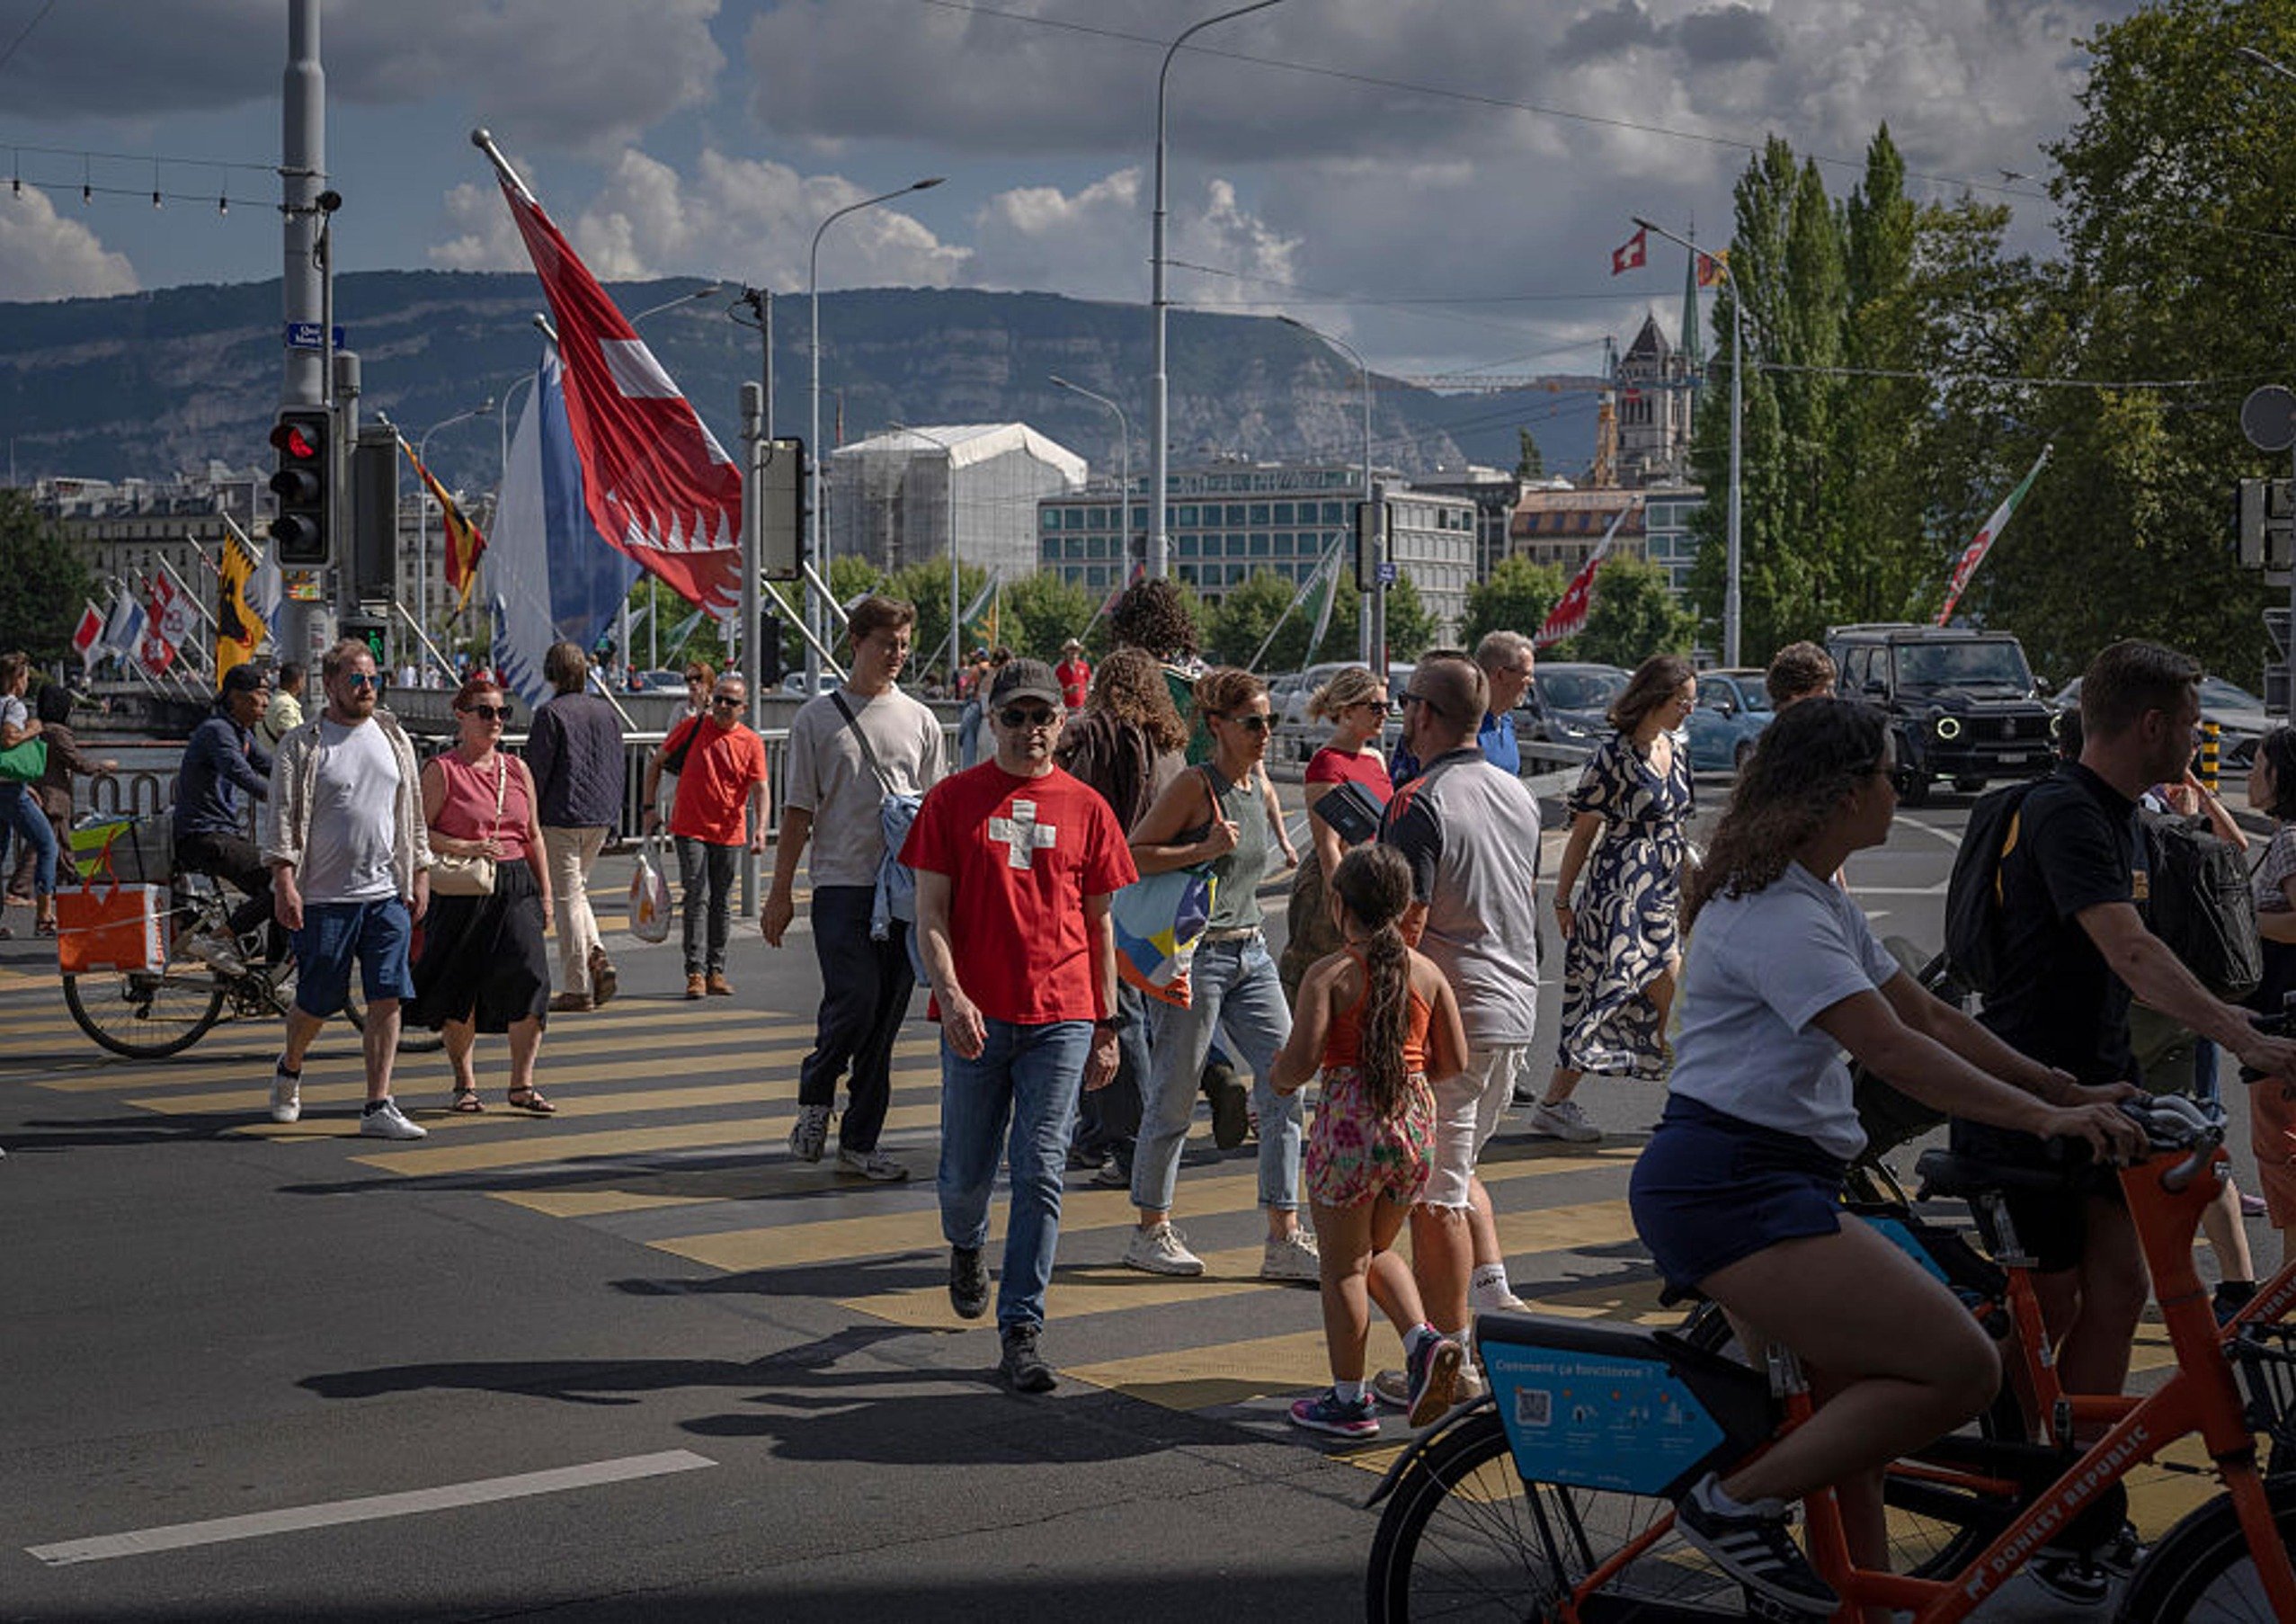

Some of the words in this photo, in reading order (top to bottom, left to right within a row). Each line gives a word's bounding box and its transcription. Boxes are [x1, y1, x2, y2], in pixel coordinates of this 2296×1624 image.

[1495, 1359, 1554, 1373] Comment
[1575, 1362, 1642, 1379] fonctionne
[1991, 1504, 2063, 1574] DONKEY
[2064, 1424, 2149, 1507] REPUBLIC
